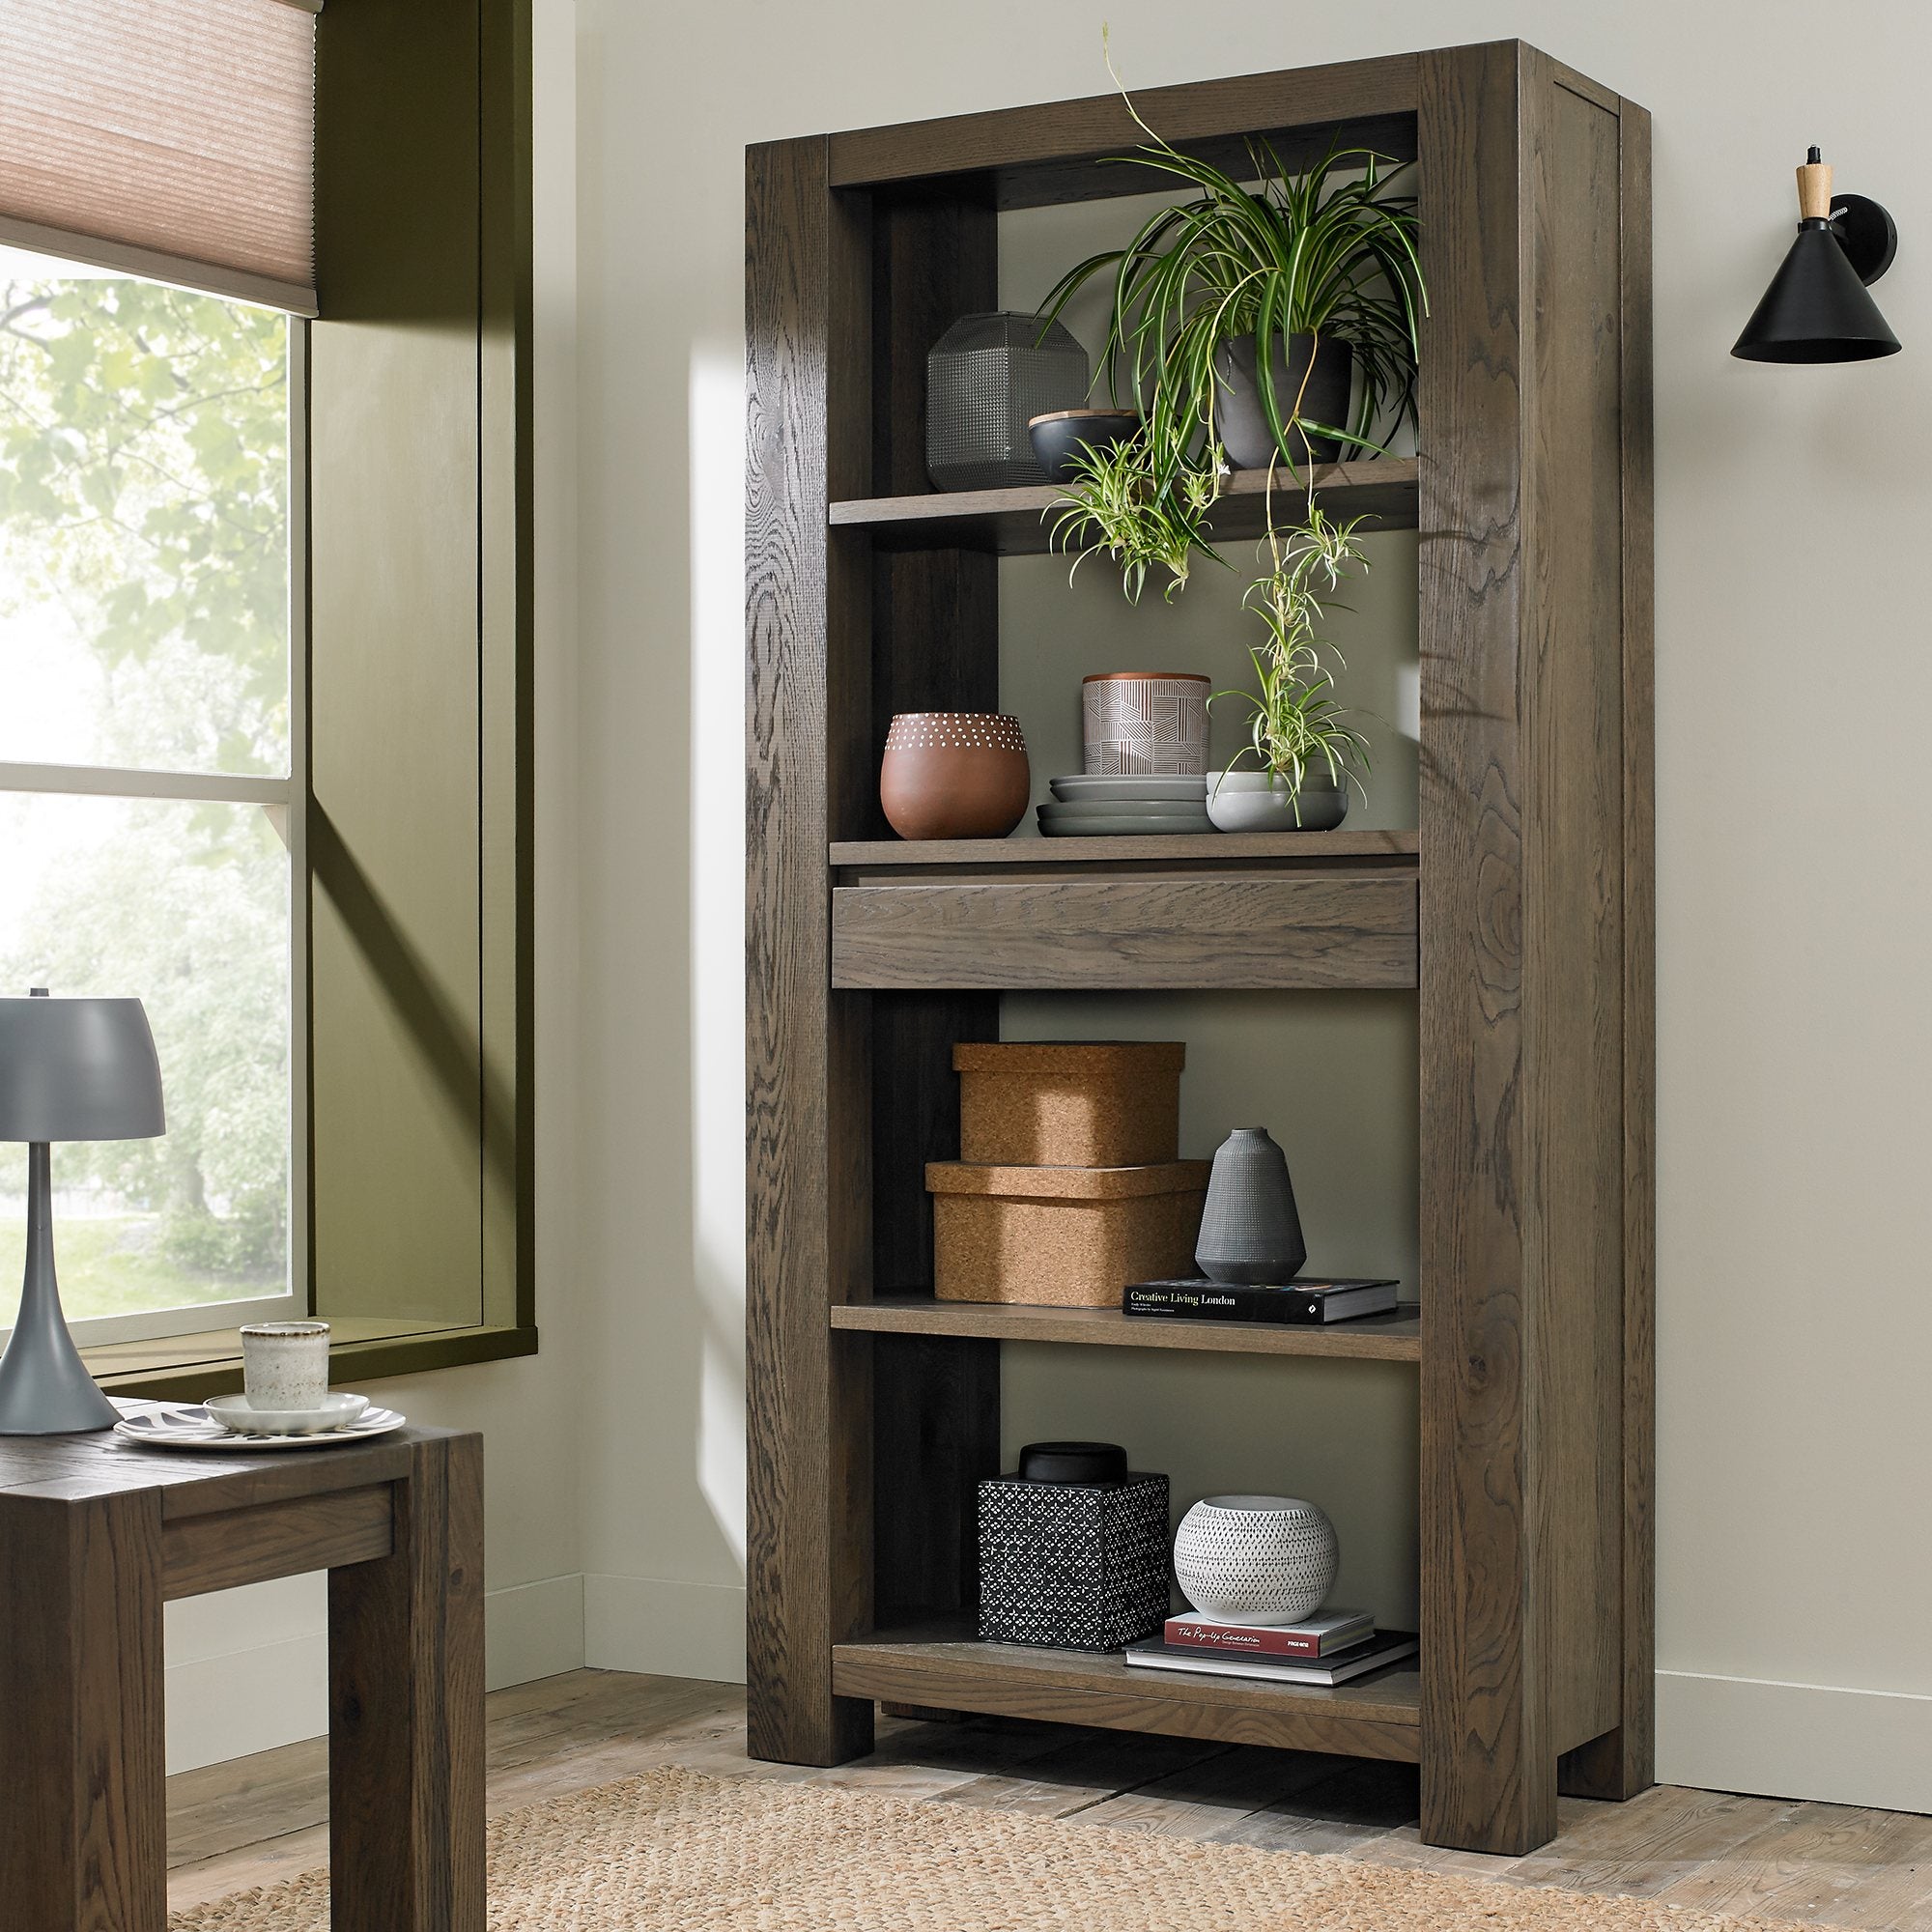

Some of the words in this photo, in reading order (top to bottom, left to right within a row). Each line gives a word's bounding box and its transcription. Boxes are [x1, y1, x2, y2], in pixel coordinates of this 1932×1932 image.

[1130, 1291, 1168, 1302] Creative
[1171, 1293, 1199, 1306] Living
[1201, 1294, 1236, 1305] London
[1178, 1627, 1191, 1637] The
[1193, 1626, 1220, 1642] Pop-Up
[1221, 1631, 1260, 1643] Generation
